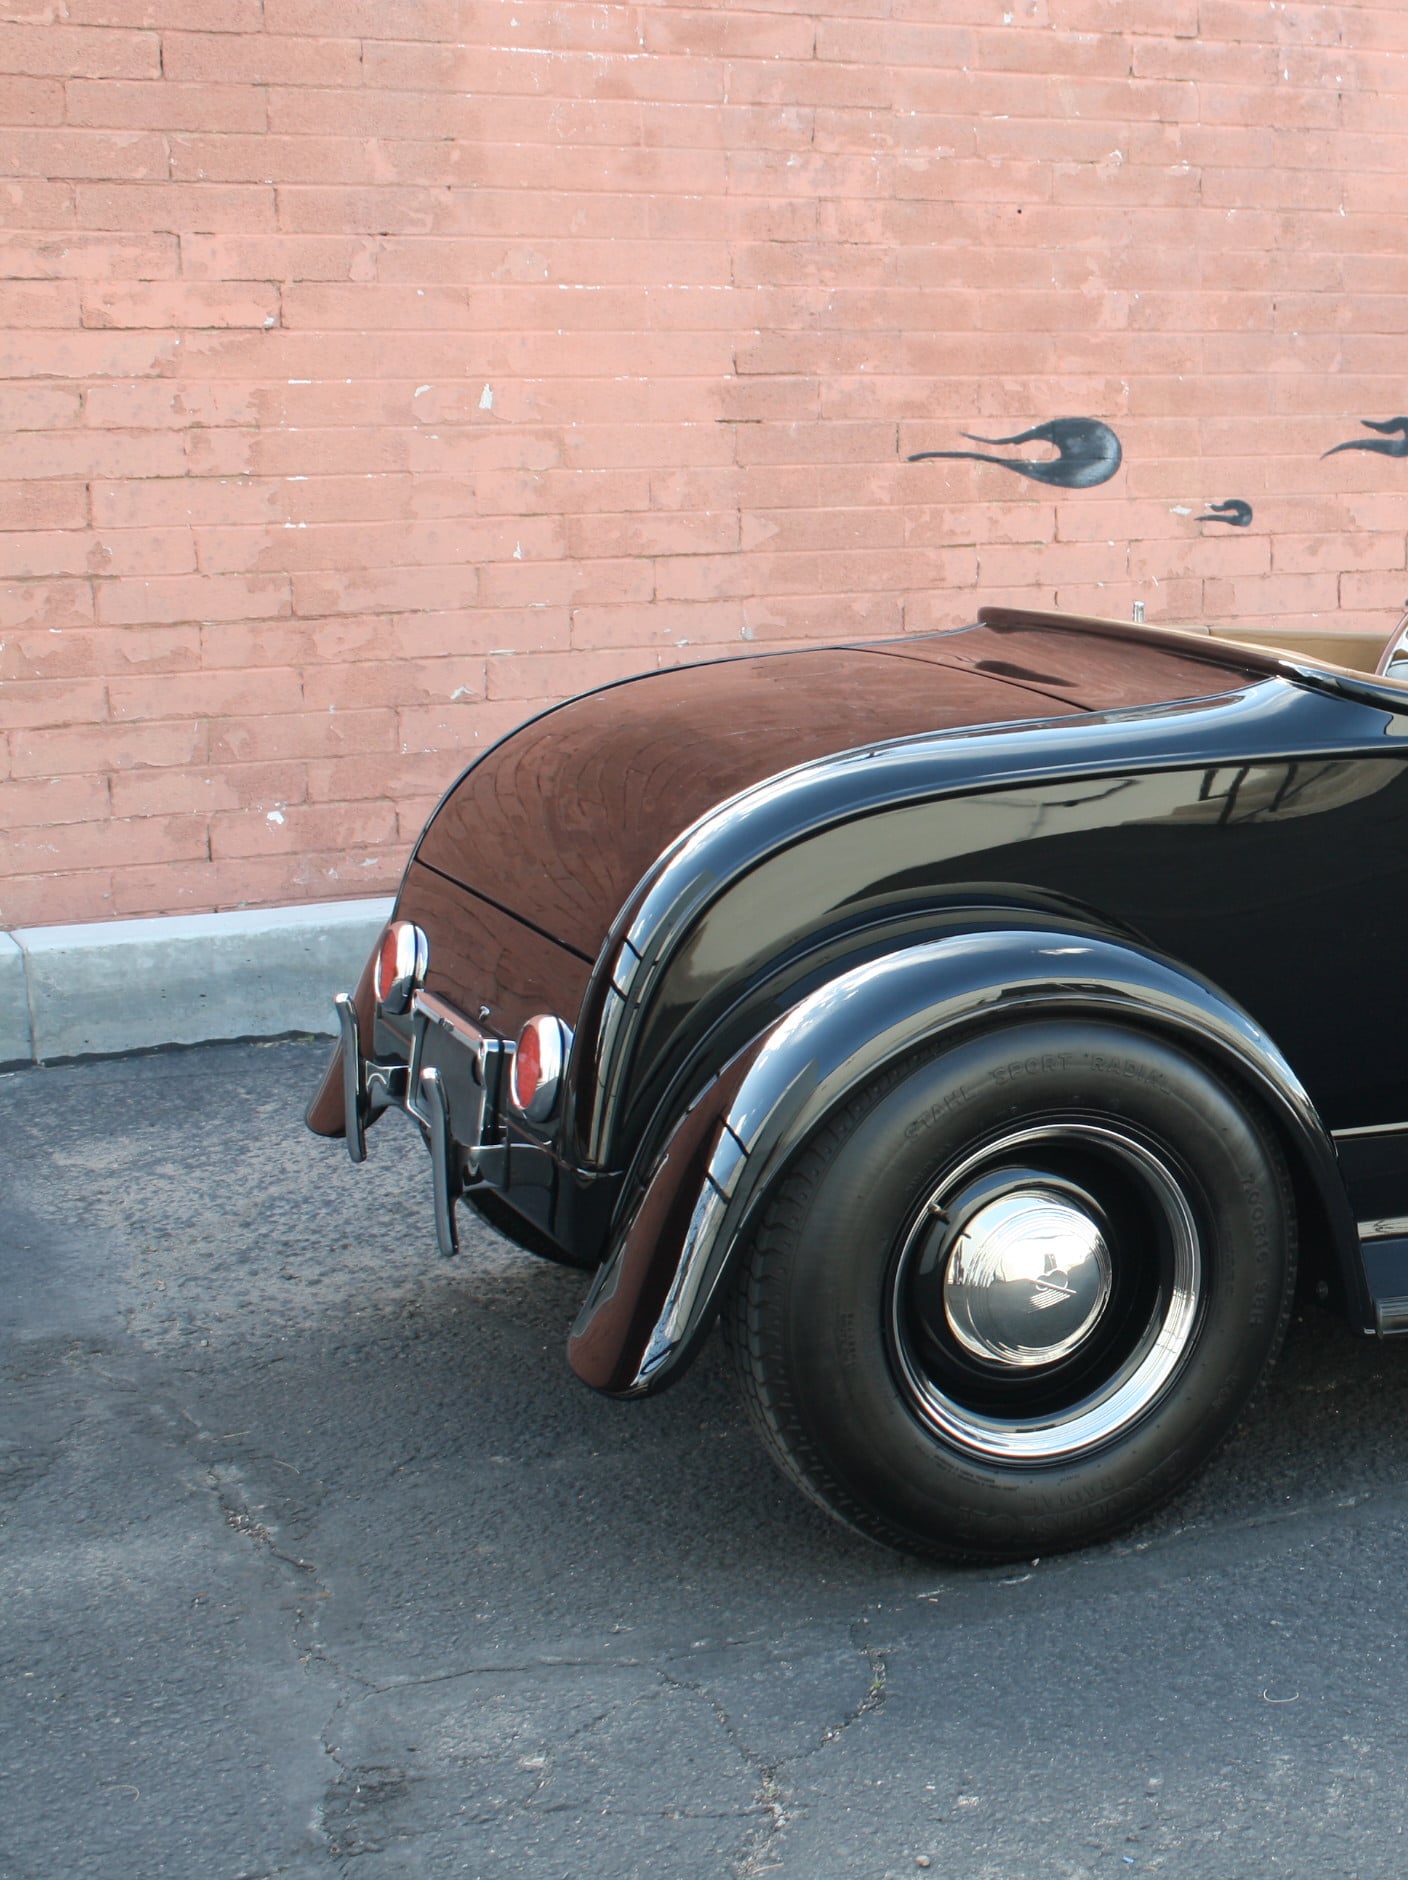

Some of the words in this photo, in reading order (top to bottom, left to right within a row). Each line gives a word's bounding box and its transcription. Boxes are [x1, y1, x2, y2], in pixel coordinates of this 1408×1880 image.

[903, 1086, 978, 1141] STAHL
[989, 1053, 1075, 1087] SPORT
[1090, 1054, 1171, 1096] RADIAL
